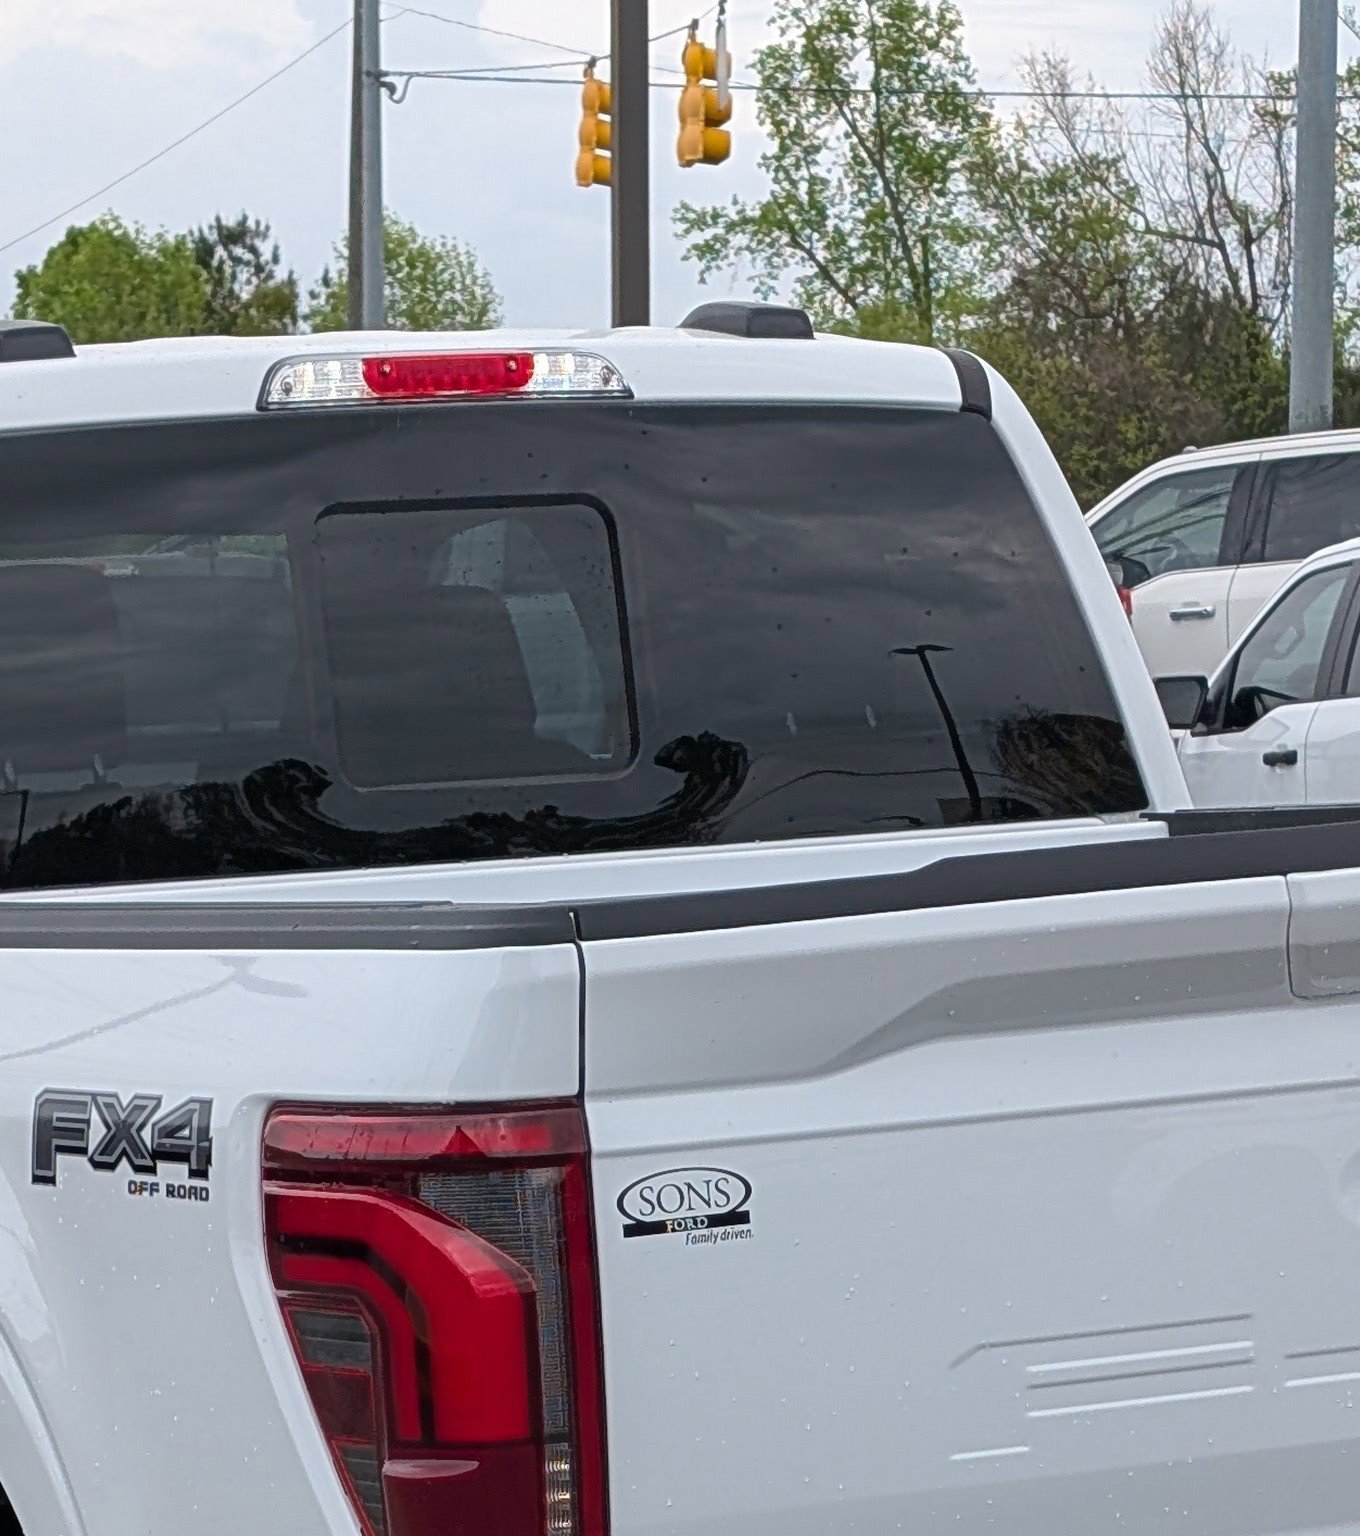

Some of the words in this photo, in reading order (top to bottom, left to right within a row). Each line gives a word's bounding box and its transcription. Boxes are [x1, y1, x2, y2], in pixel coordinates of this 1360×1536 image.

[31, 1087, 214, 1187] FX4
[127, 1179, 160, 1197] OFF
[165, 1183, 210, 1202] ROAD
[638, 1177, 731, 1217] SONS
[665, 1217, 708, 1234] FORD
